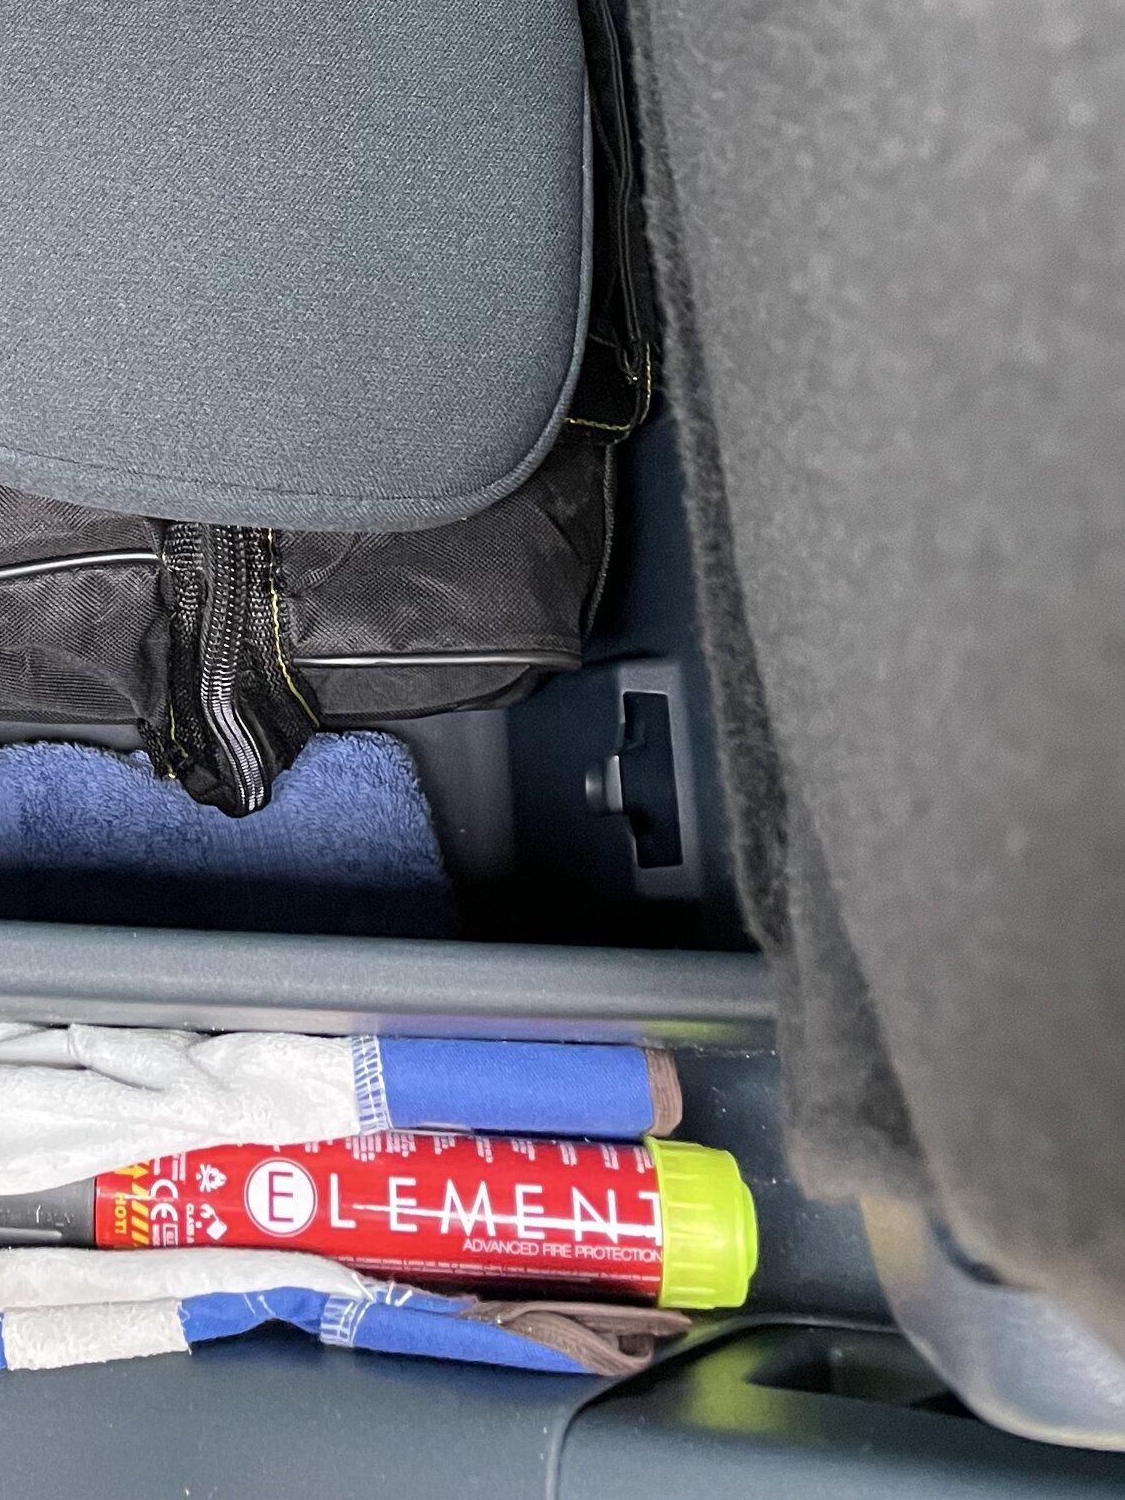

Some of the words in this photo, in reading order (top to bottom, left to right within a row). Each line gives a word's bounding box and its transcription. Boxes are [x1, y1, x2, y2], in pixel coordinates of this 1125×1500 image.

[463, 1238, 540, 1257] ADVANCED
[542, 1243, 573, 1260] FIRE
[575, 1245, 663, 1265] PROTECTION
